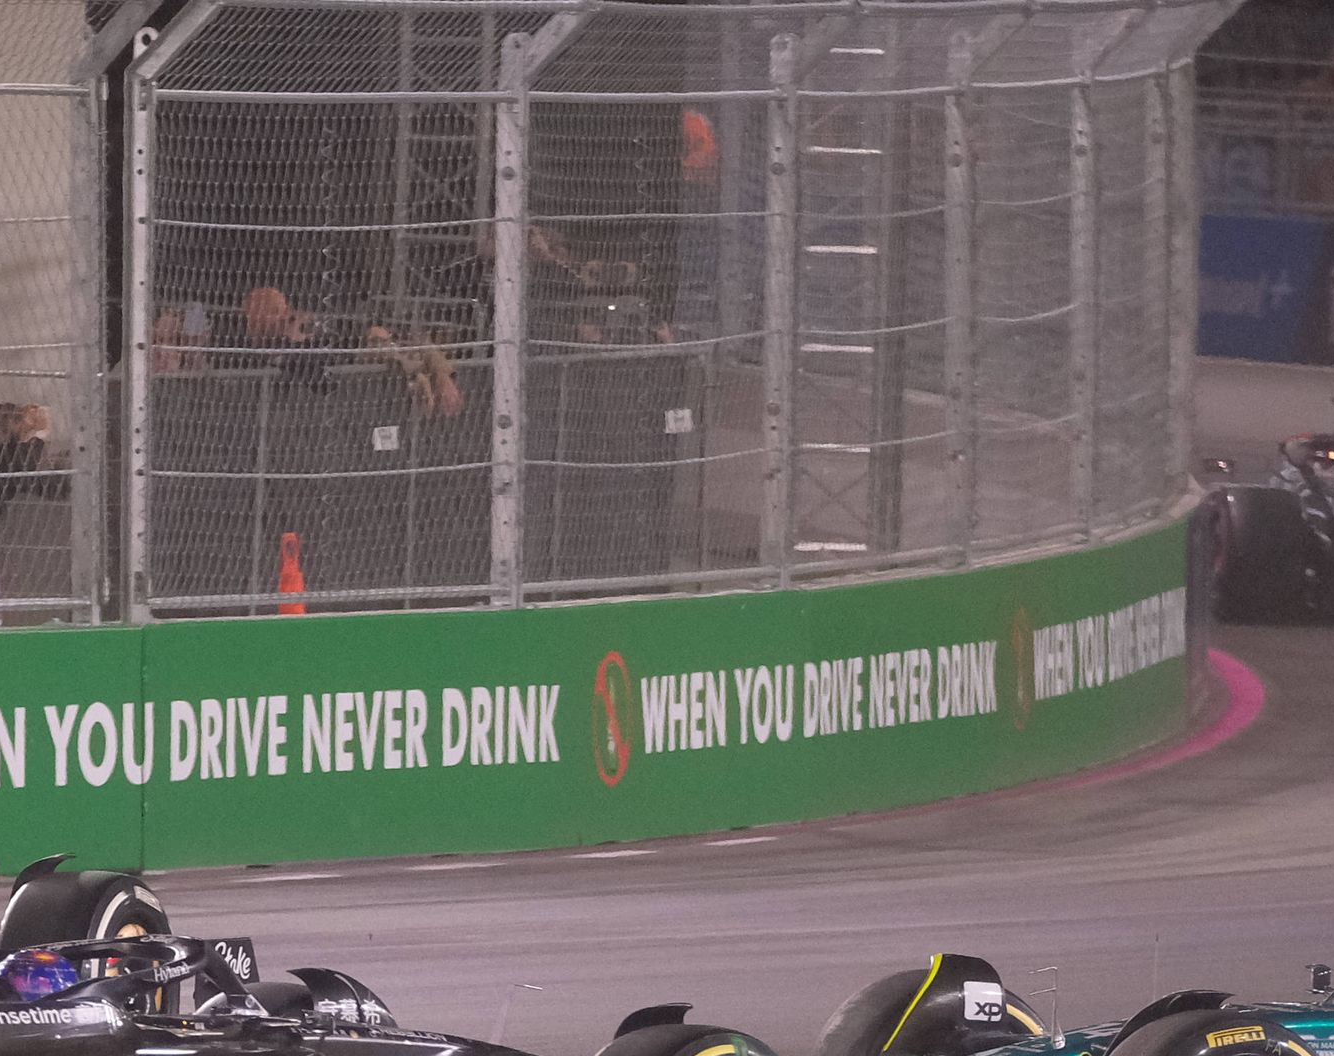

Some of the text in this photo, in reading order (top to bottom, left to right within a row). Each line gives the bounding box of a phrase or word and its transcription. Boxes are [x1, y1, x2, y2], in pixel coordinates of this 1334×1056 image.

[641, 640, 998, 754] WHEN YOU DRIVE NEVER DRINK
[43, 701, 155, 786] YOU
[169, 694, 288, 783] DRIVE
[302, 688, 429, 775] NEVER
[441, 684, 562, 768] DRINK
[215, 941, 251, 980] Stake
[1205, 1025, 1267, 1048] PIRELLI
